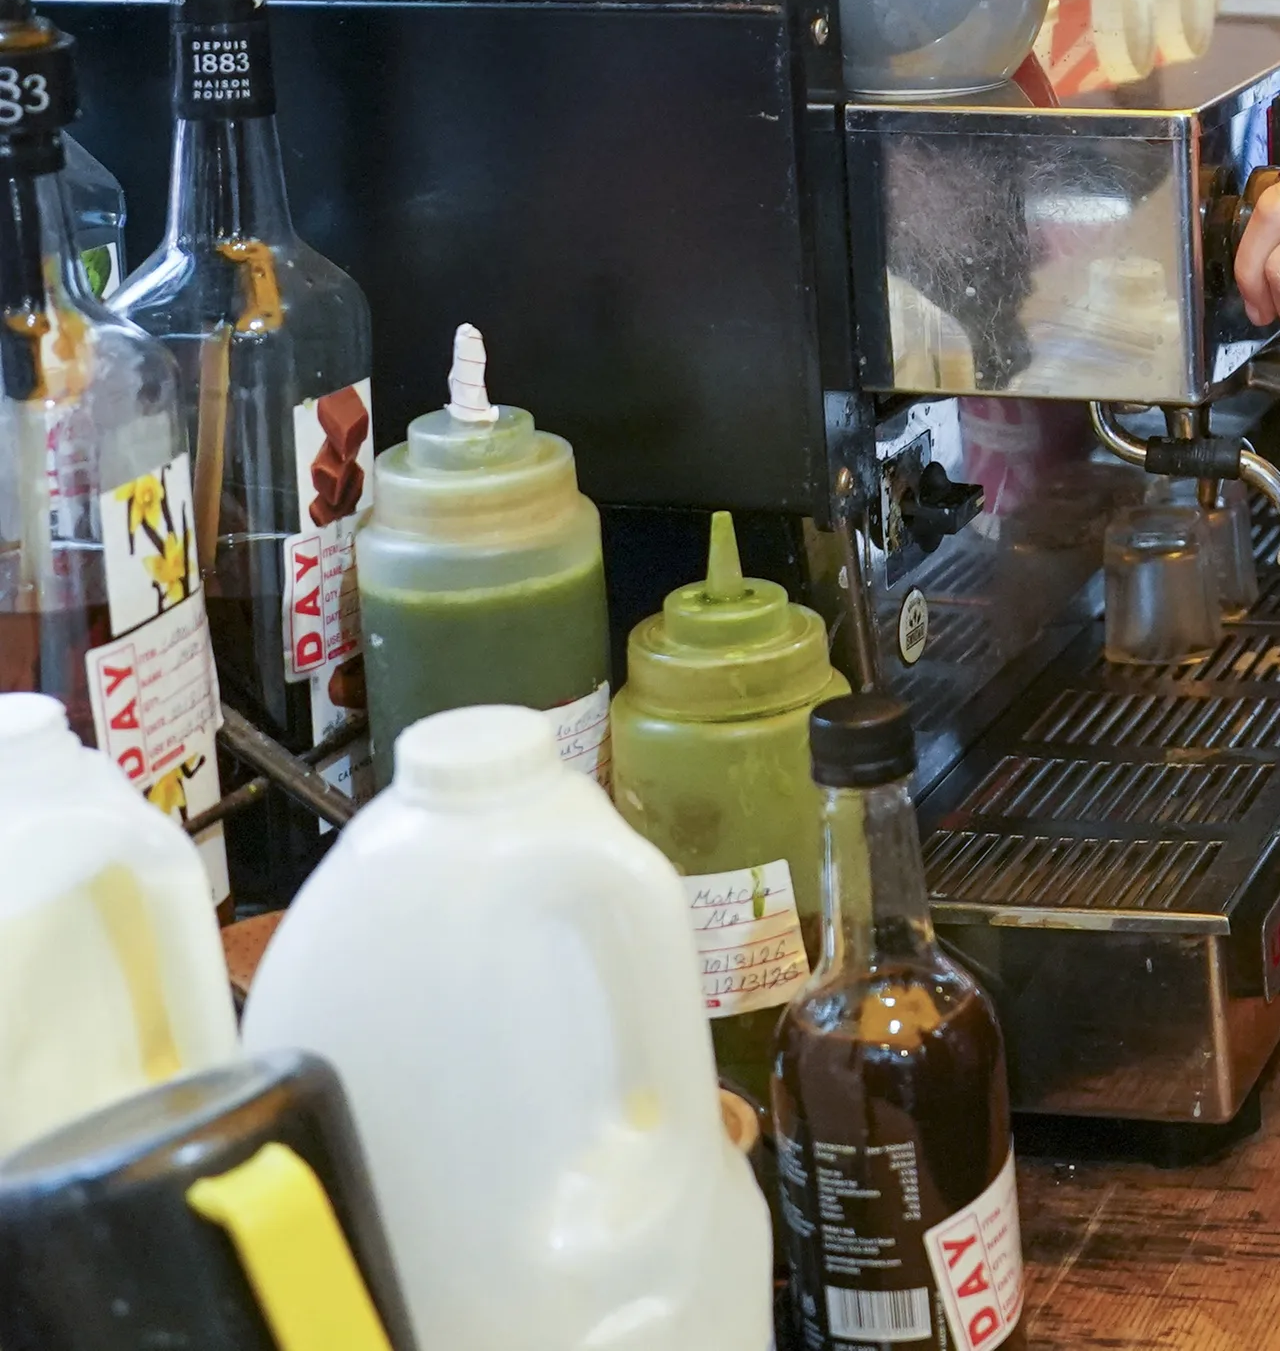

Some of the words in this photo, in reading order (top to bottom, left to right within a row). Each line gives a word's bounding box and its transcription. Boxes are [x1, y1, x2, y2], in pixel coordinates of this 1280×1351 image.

[192, 40, 248, 51] DEPUIS
[193, 52, 250, 74] 1883
[193, 78, 250, 89] MAISON
[193, 89, 251, 100] ROUTIN
[294, 552, 323, 668] DAY
[942, 1234, 999, 1347] DAY
